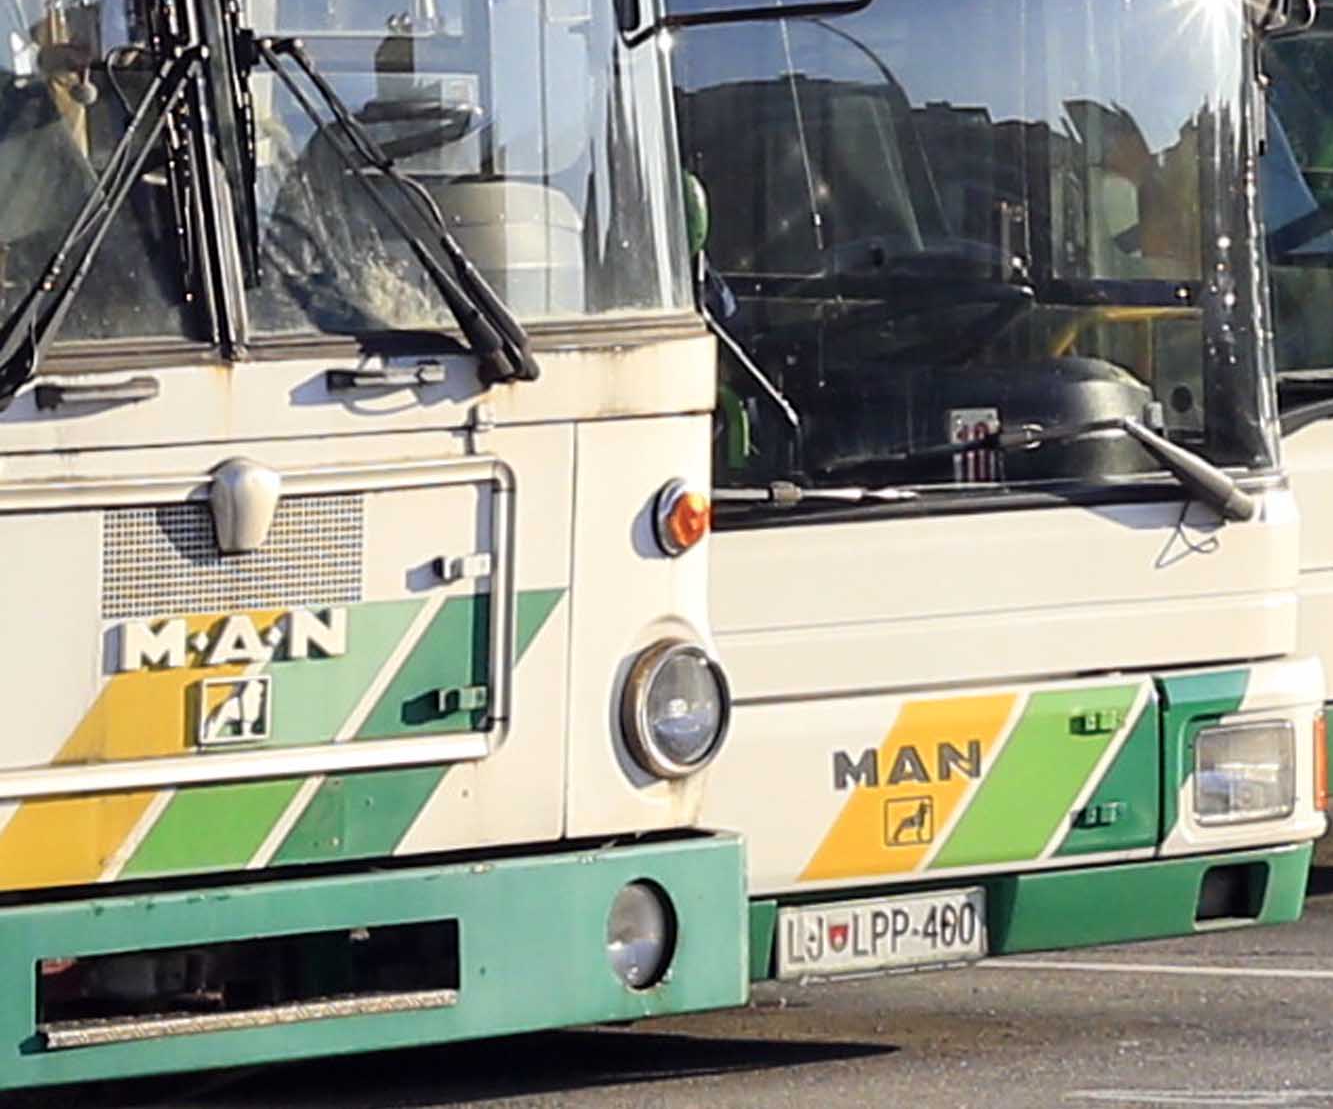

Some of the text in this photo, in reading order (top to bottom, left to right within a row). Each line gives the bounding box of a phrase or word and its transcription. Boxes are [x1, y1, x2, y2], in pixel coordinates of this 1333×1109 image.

[832, 739, 982, 790] MAN
[787, 901, 976, 965] LJ LPP-460
